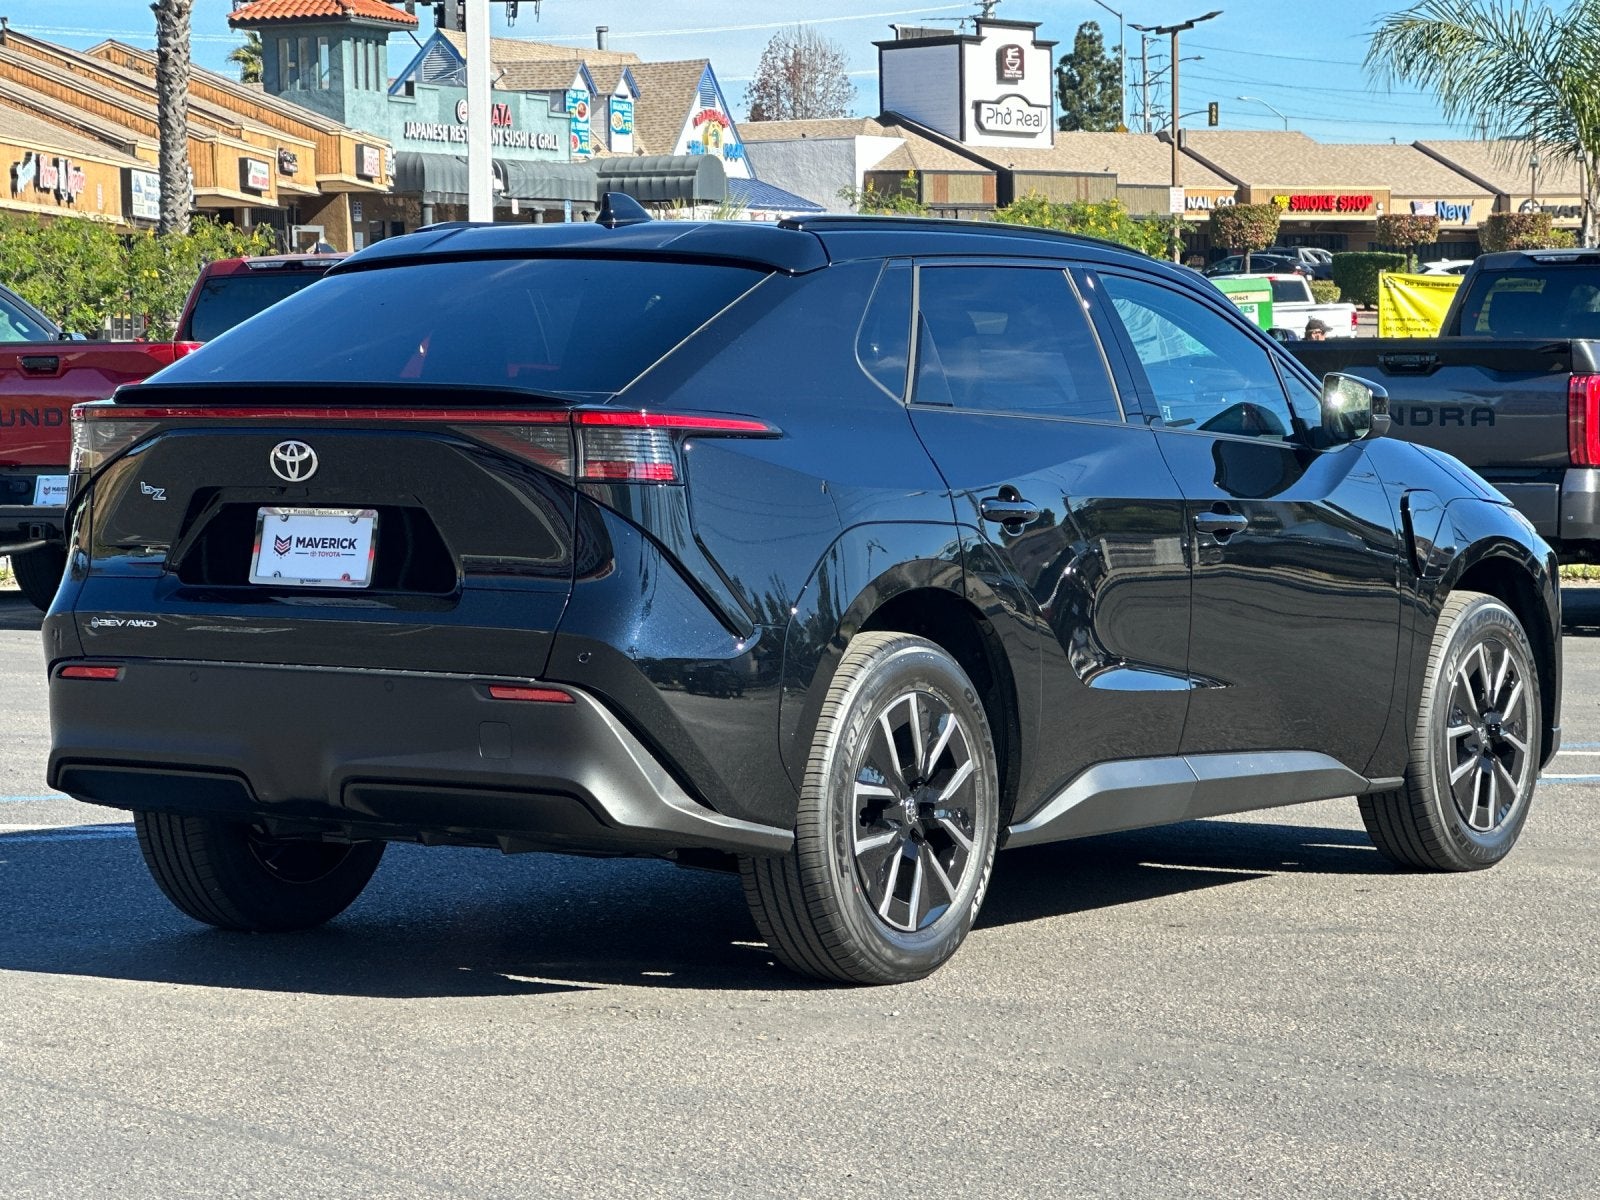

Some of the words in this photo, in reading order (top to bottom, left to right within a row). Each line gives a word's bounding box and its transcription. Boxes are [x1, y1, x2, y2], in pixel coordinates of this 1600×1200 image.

[1016, 109, 1042, 127] Real
[405, 122, 448, 141] JAPANESE
[451, 126, 503, 146] RESTNT
[505, 130, 529, 147] SUSHI
[530, 133, 538, 148] &
[539, 134, 560, 151] GRILL
[1187, 196, 1214, 208] NAIL
[1291, 195, 1336, 210] SMOKE
[1339, 195, 1373, 210] SHOP
[1437, 201, 1473, 223] Navy
[295, 536, 358, 550] MAVERICK
[99, 619, 126, 627] BEV
[126, 619, 158, 628] AWD
[963, 687, 995, 760] OPEN
